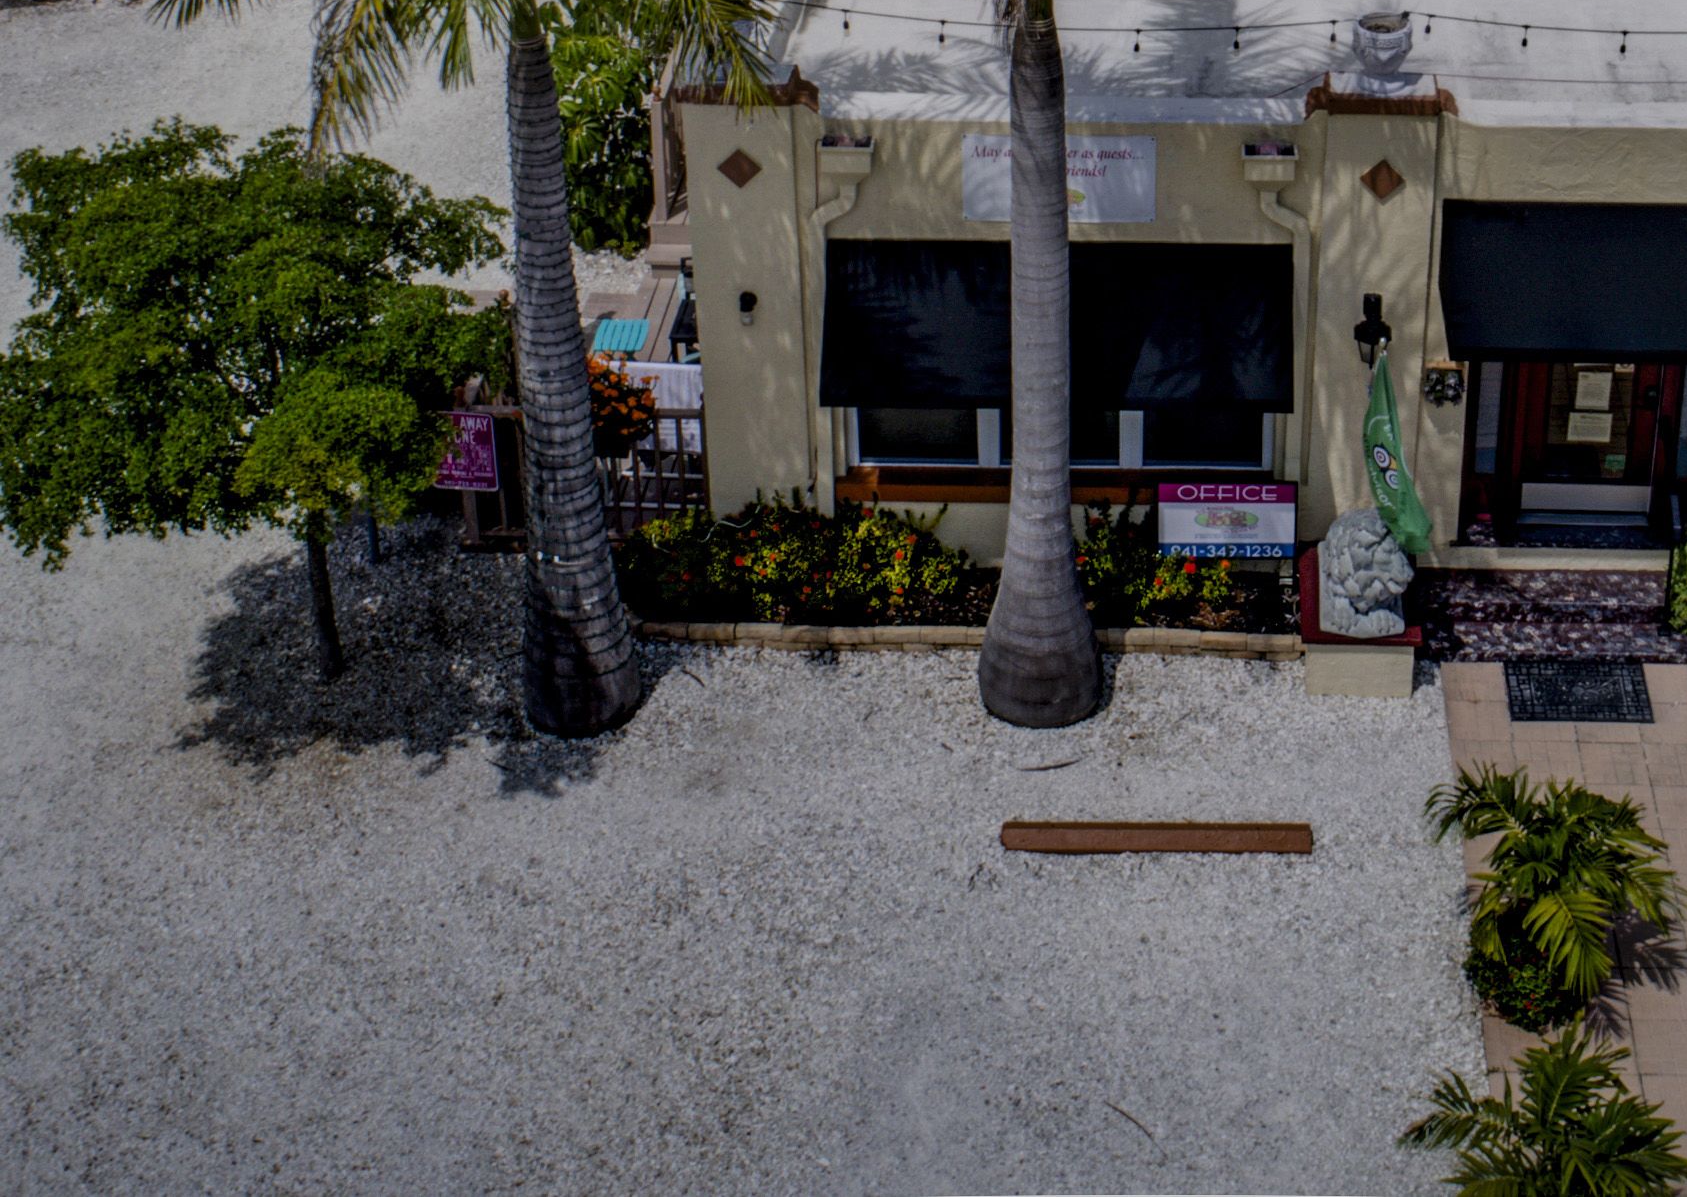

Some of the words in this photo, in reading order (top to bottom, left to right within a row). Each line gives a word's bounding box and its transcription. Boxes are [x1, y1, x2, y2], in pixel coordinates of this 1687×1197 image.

[971, 145, 1002, 162] May
[1064, 164, 1108, 178] riends!
[460, 416, 489, 432] AWAY
[1177, 484, 1278, 501] OFFICE
